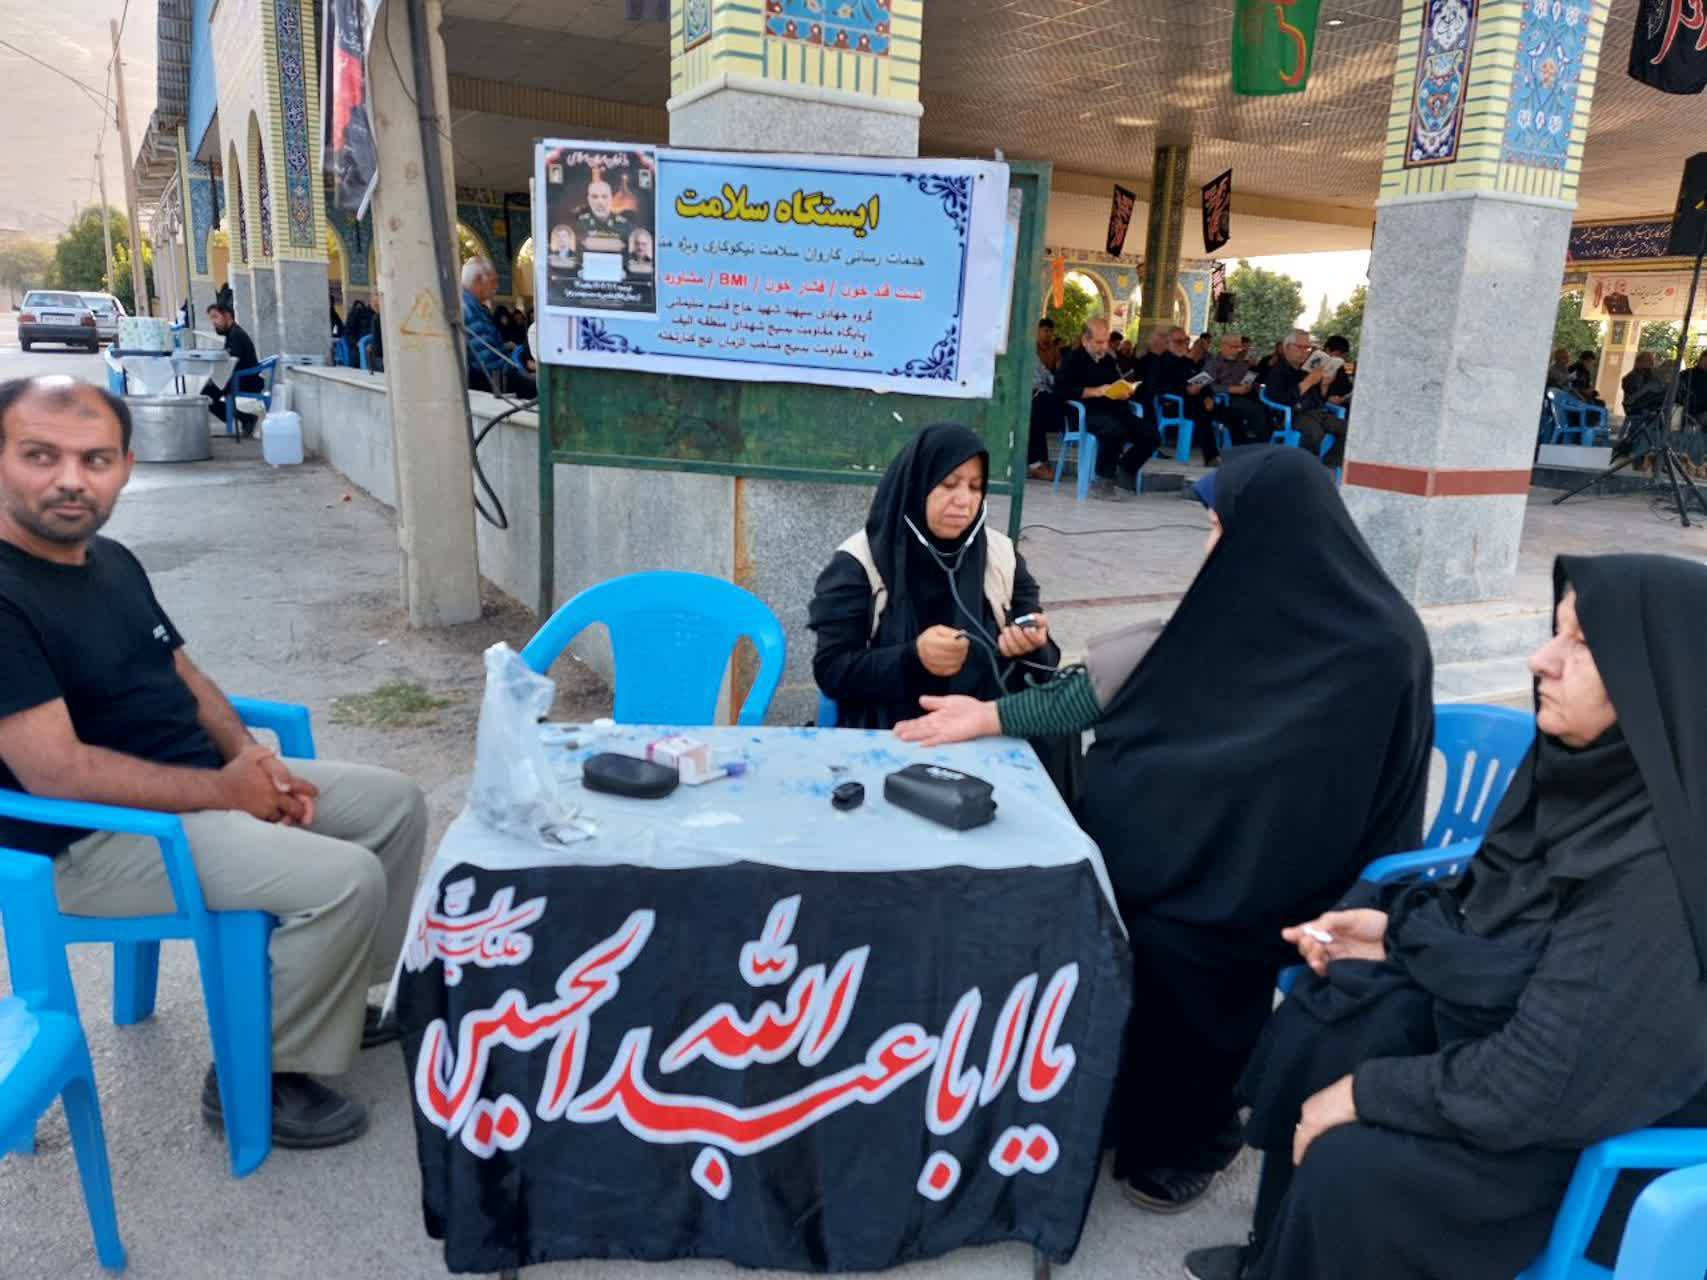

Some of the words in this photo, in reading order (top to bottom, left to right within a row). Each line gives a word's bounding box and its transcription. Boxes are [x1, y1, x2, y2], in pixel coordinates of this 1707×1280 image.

[674, 182, 770, 222] سلامت
[774, 188, 880, 238] ایستگاه
[677, 236, 698, 255] ویژه
[702, 238, 755, 257] نیکوکاری
[759, 243, 800, 257] سلامت
[803, 246, 842, 263] کاروان
[844, 250, 881, 267] رسانی
[885, 250, 925, 267] خدمات
[719, 272, 748, 287] BMI
[765, 279, 793, 293] خون
[841, 284, 869, 298] خون
[415, 908, 656, 1160] الحسین
[988, 961, 1080, 1175] یا
